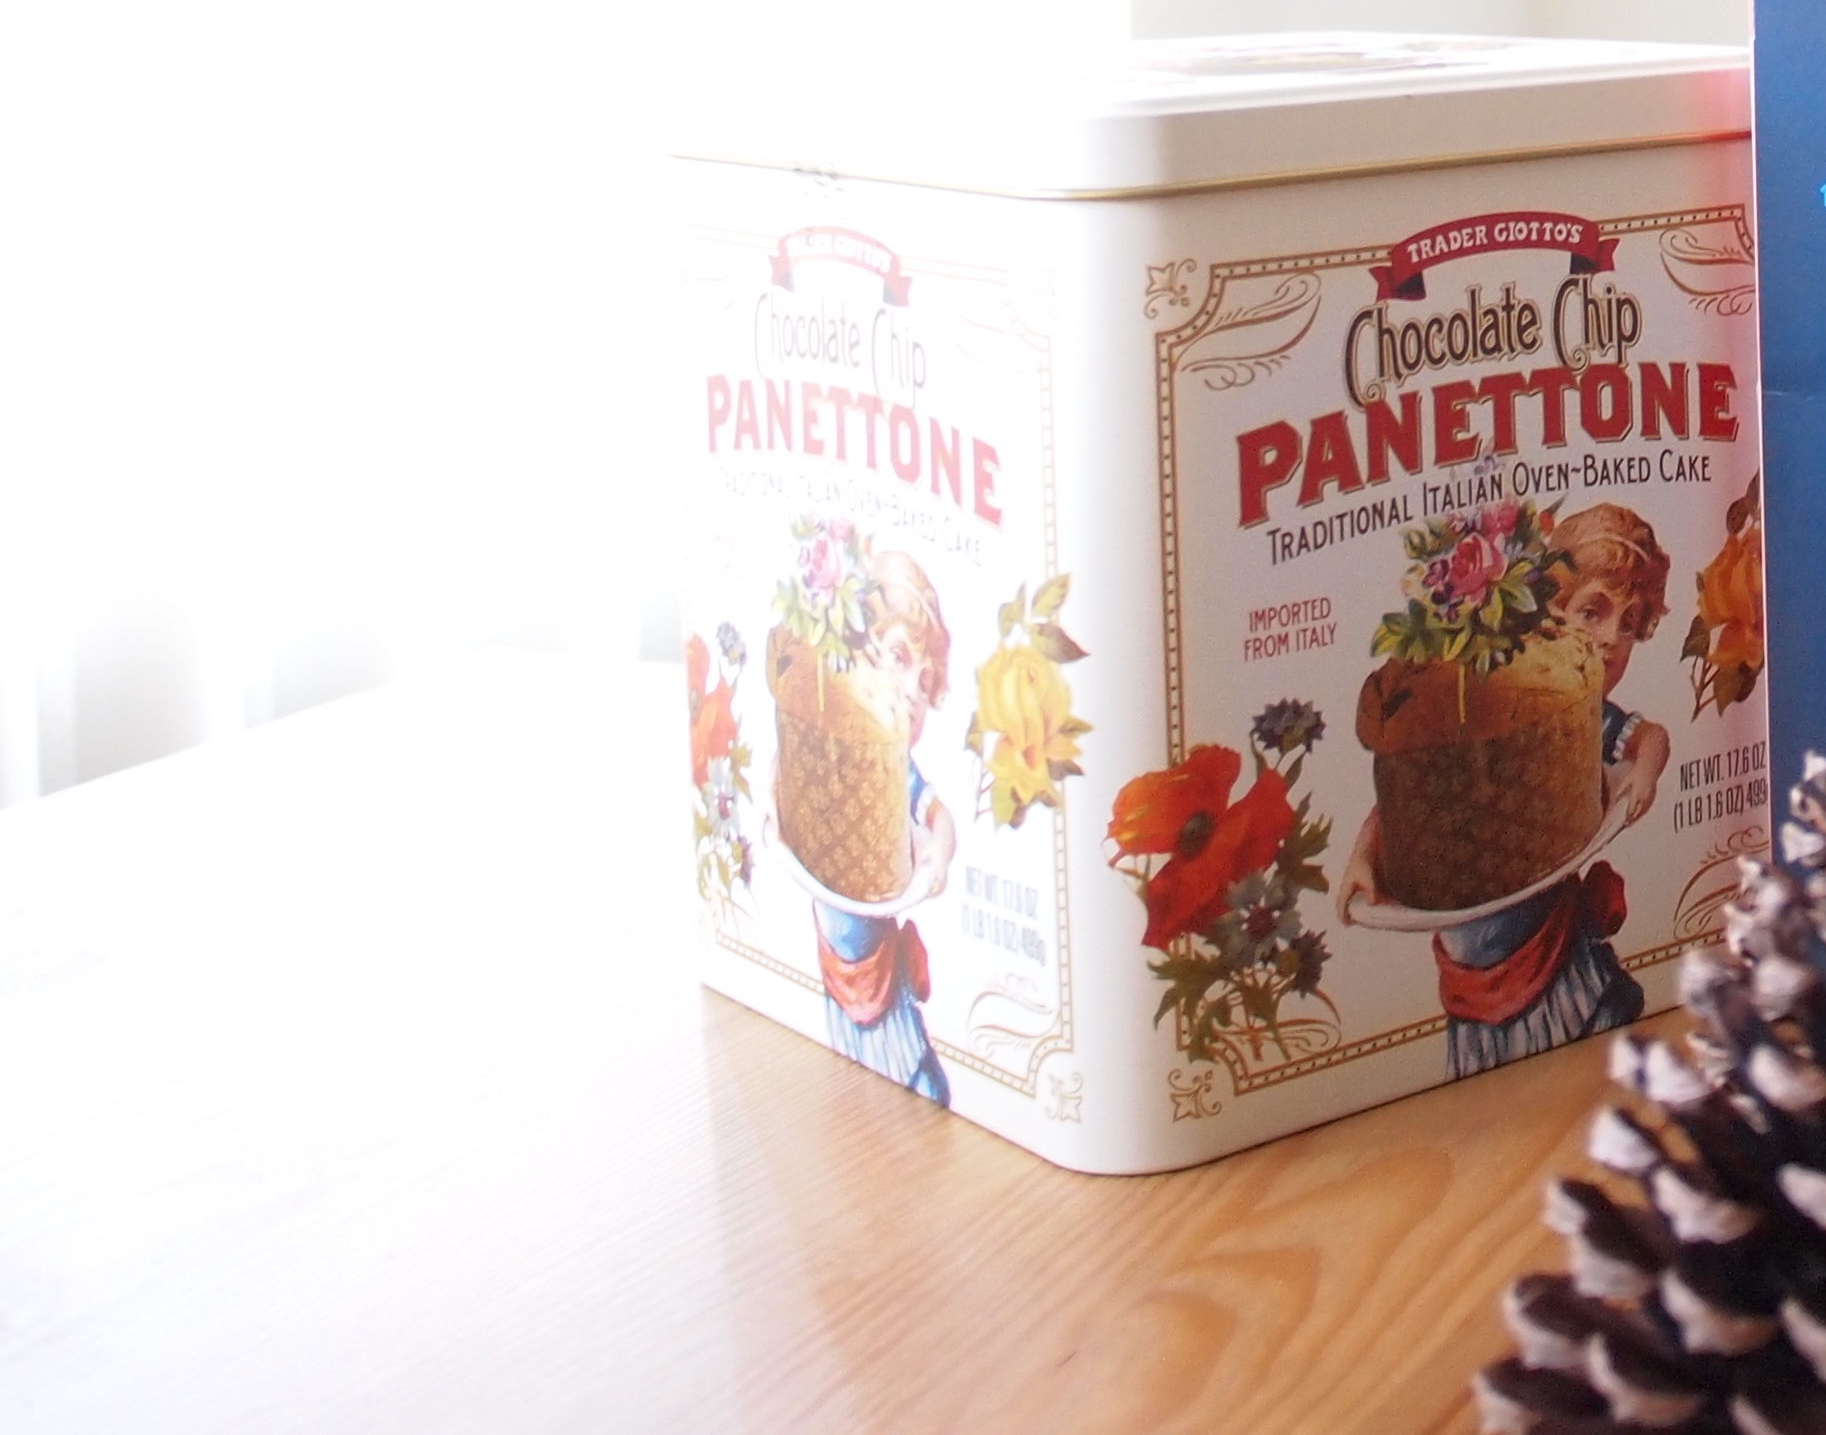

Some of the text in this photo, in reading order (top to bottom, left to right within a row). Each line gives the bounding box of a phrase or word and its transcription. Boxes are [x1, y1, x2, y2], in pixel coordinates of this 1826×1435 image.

[1407, 221, 1584, 263] TRADER GIOTTO'S
[753, 292, 927, 409] Chocolate Chip
[1343, 274, 1642, 408] Chocolate Chip
[706, 373, 1004, 533] PANETTONE
[1235, 362, 1740, 529] PANETTONE
[1267, 496, 1414, 566] TRADITIONAL
[1422, 470, 1503, 518] ITALIAN
[1658, 449, 1712, 483] CAKE
[1244, 622, 1338, 662] FROM ITALY
[1249, 597, 1332, 633] IMPORTED
[1673, 777, 1768, 834] (1 LB 1.6 OZ) 499
[1680, 740, 1766, 792] NET WT. 17.6 OZ
